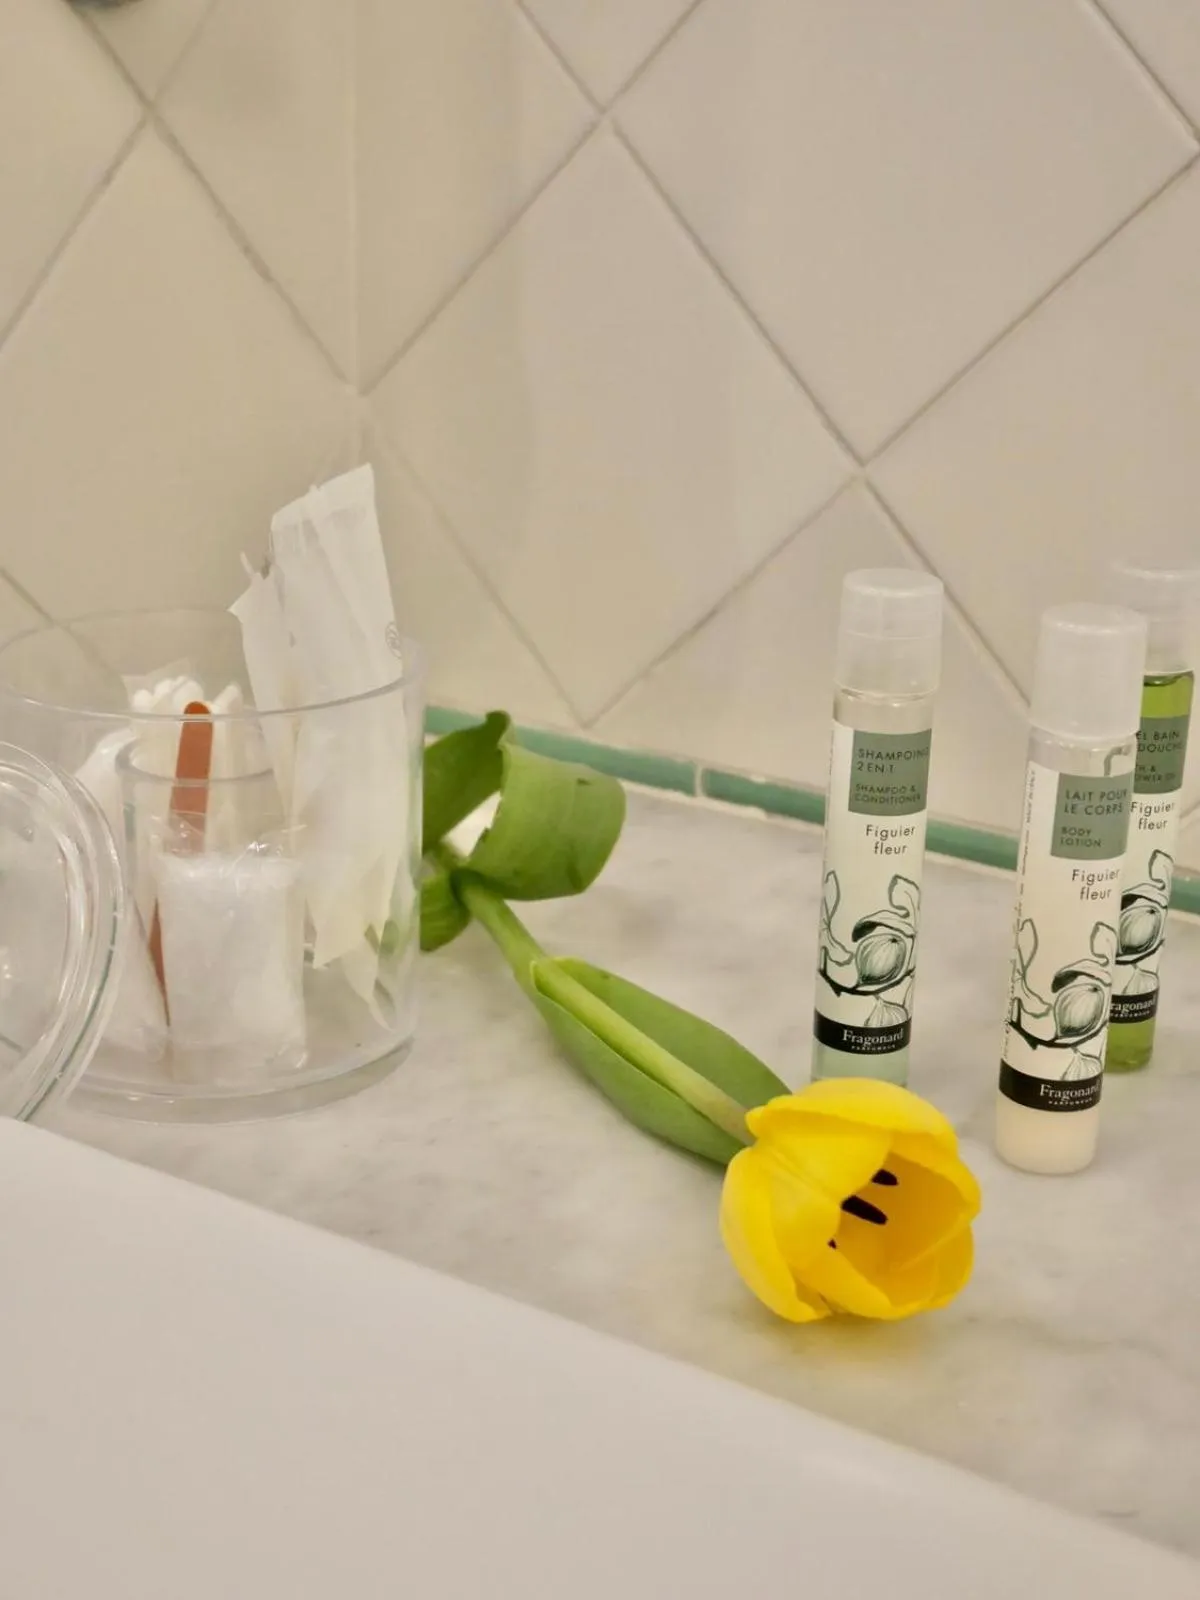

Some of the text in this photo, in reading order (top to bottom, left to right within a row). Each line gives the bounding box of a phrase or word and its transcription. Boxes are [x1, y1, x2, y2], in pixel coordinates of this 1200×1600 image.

[1153, 731, 1180, 741] BAIN
[857, 760, 865, 772] 2
[867, 763, 885, 773] EN
[855, 783, 908, 795] SHAMPOO
[1065, 789, 1094, 802] LAIT
[1063, 802, 1124, 816] LE CORPS
[1131, 801, 1175, 818] Figuier
[1138, 817, 1169, 831] fleur
[865, 823, 916, 842] Figuier
[1061, 826, 1092, 837] BODY
[874, 841, 908, 856] fleur
[1060, 837, 1102, 848] LOTION
[1072, 868, 1120, 887] Figuier
[1079, 887, 1112, 902] fleur
[1109, 994, 1156, 1015] ragonard
[842, 1028, 904, 1048] Fragonard
